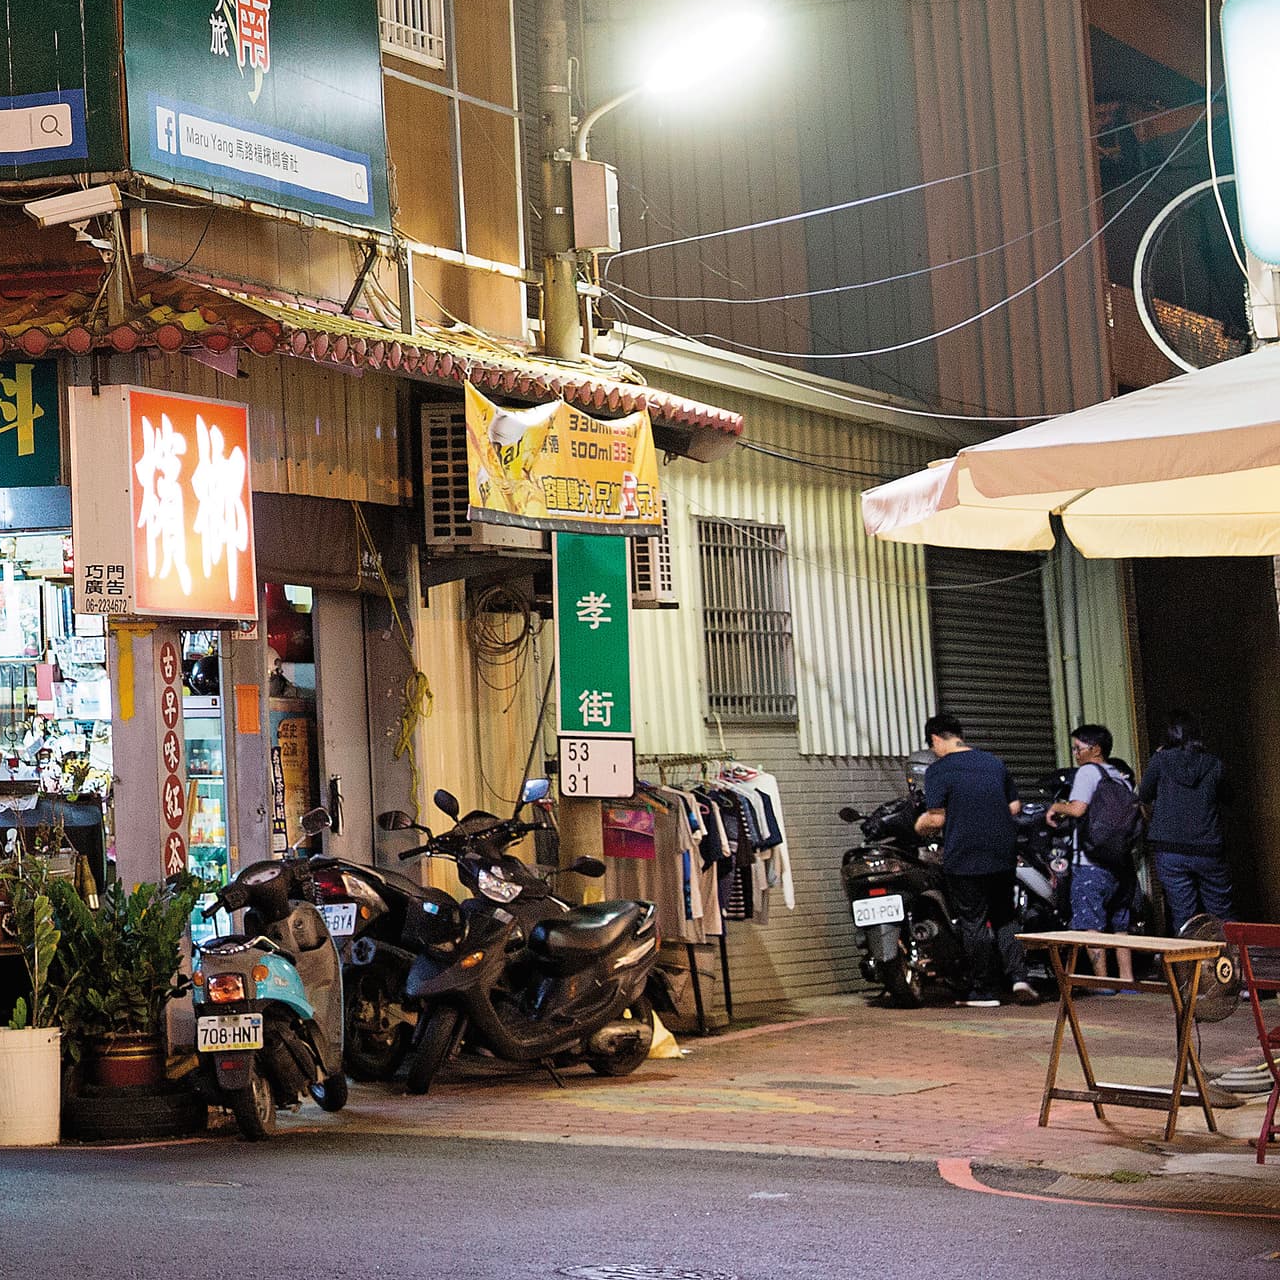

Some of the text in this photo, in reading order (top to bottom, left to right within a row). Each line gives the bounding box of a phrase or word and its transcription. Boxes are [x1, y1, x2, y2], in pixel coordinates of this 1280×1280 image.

[186, 126, 209, 148] Maru
[210, 133, 234, 158] Yang
[134, 412, 249, 603] 檳榔
[84, 580, 125, 595] 廣告
[85, 598, 127, 613] 06-2234672
[162, 646, 184, 875] 古早味紅茶
[568, 742, 590, 762] 53
[568, 774, 590, 794] 31
